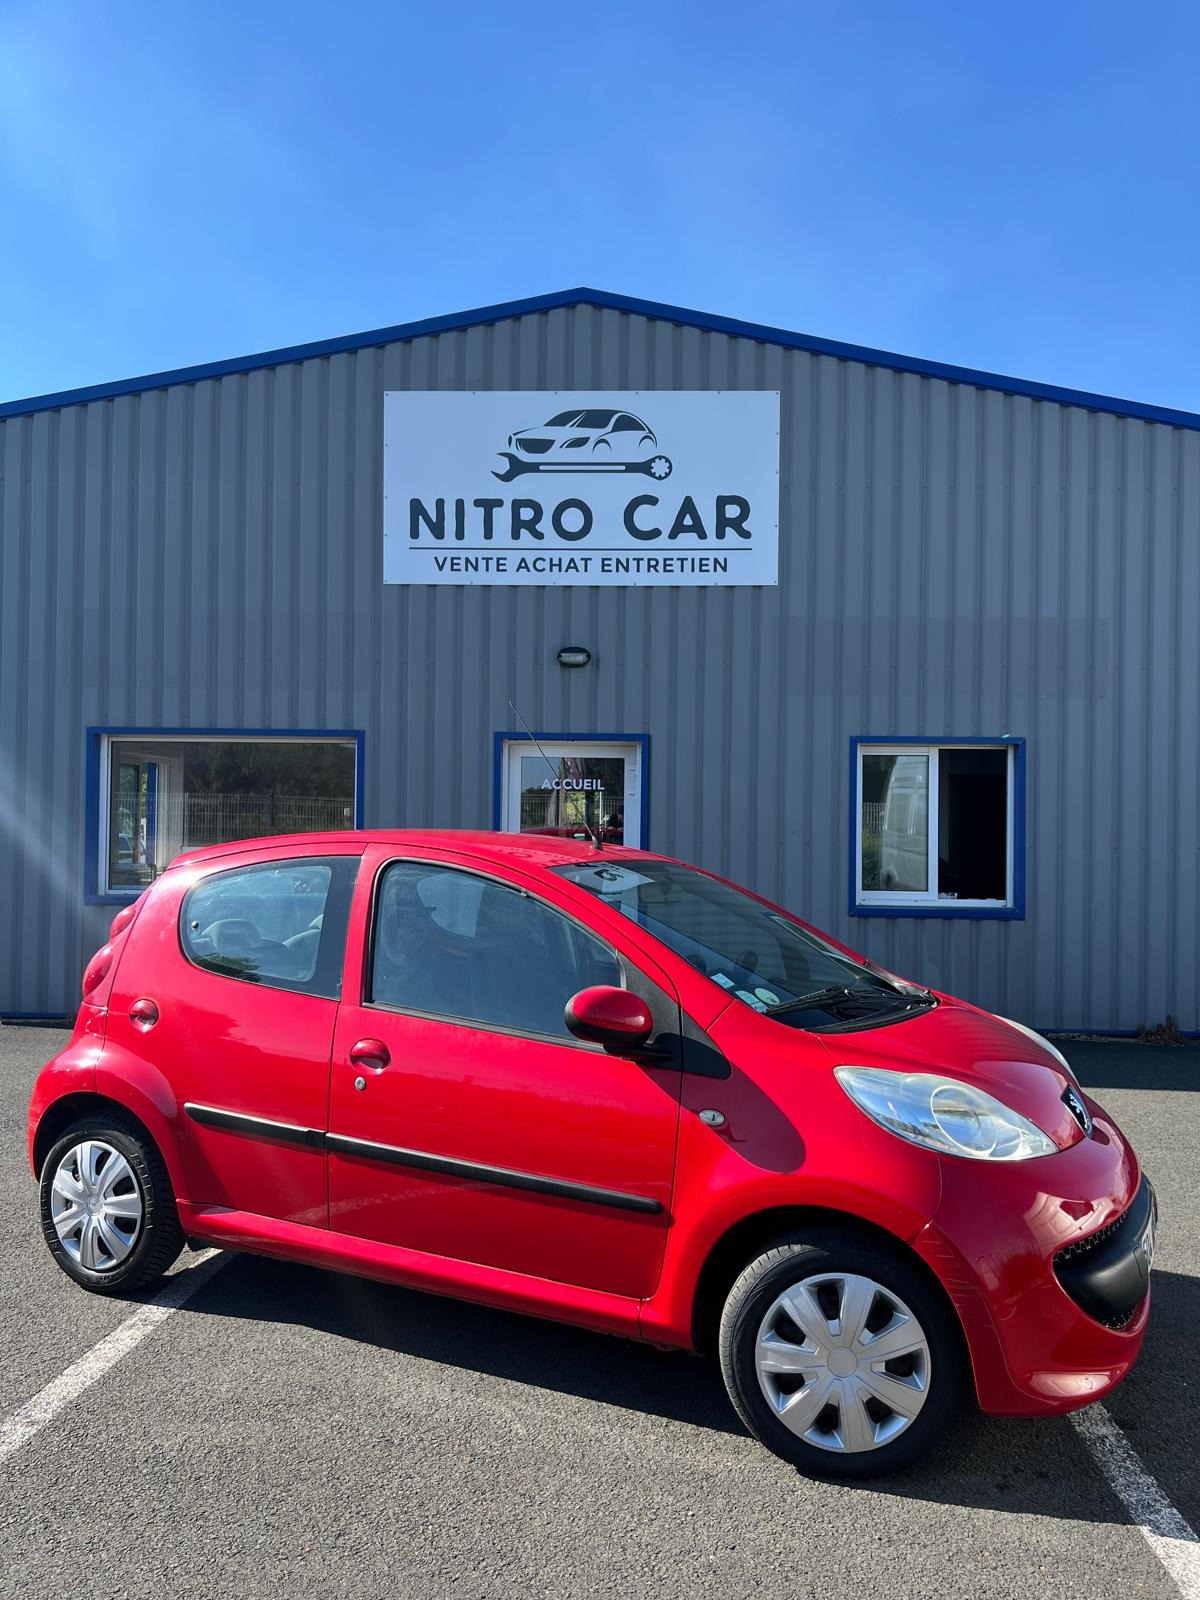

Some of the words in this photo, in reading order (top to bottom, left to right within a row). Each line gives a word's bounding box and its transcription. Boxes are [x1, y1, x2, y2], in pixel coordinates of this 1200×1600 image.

[409, 497, 594, 542] NITRO
[623, 494, 752, 541] CAR
[433, 556, 508, 573] VENTE
[515, 556, 593, 573] ACHAT
[600, 557, 729, 574] ENTRETIEN
[541, 778, 605, 790] ACCUEIL
